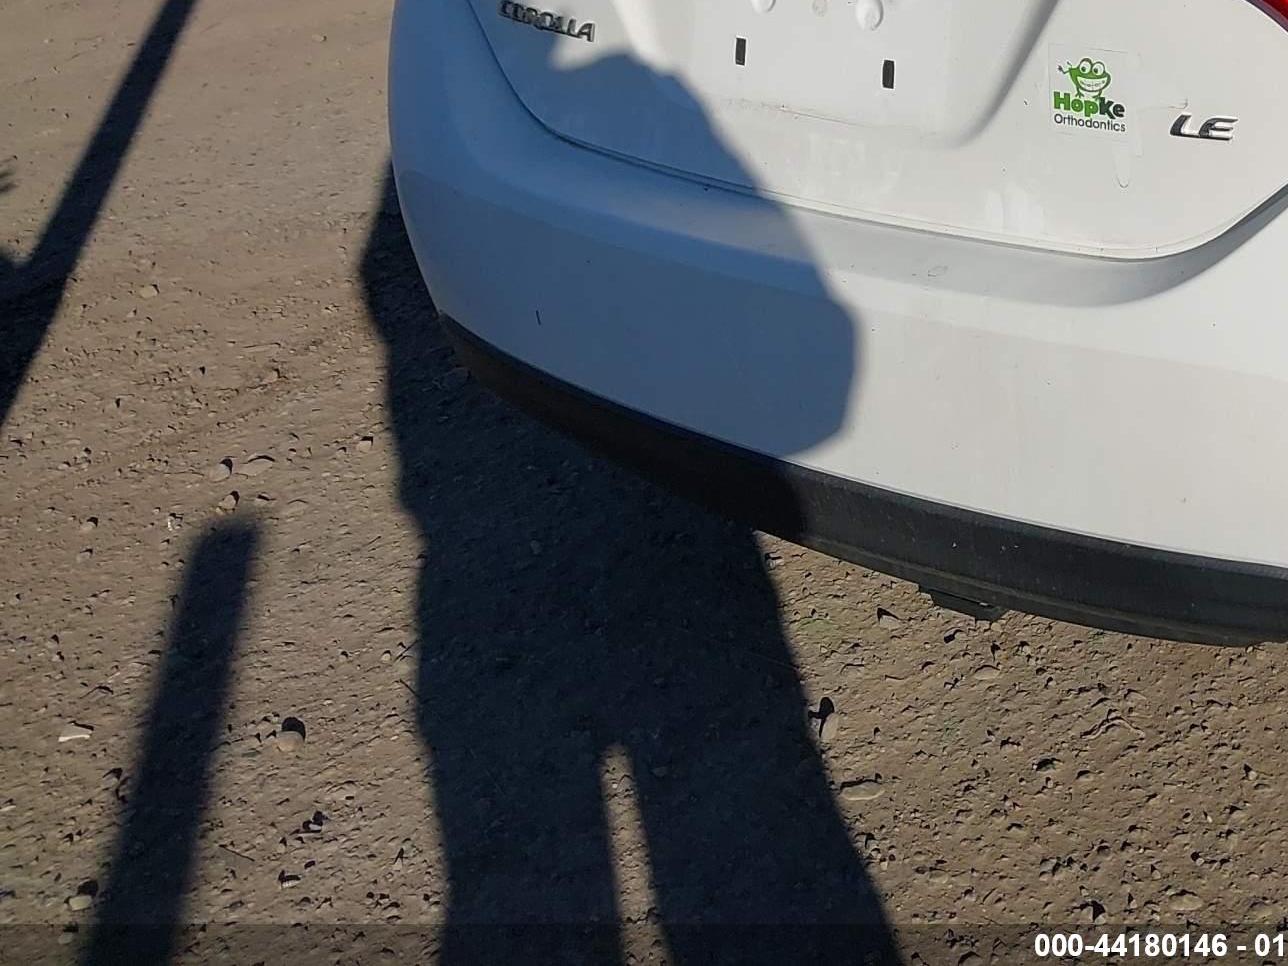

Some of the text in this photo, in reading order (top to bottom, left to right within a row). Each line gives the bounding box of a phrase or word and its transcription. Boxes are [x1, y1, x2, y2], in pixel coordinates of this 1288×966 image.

[500, 0, 596, 43] COROLLA
[1053, 113, 1126, 133] Orthodontics
[1169, 113, 1239, 141] LE
